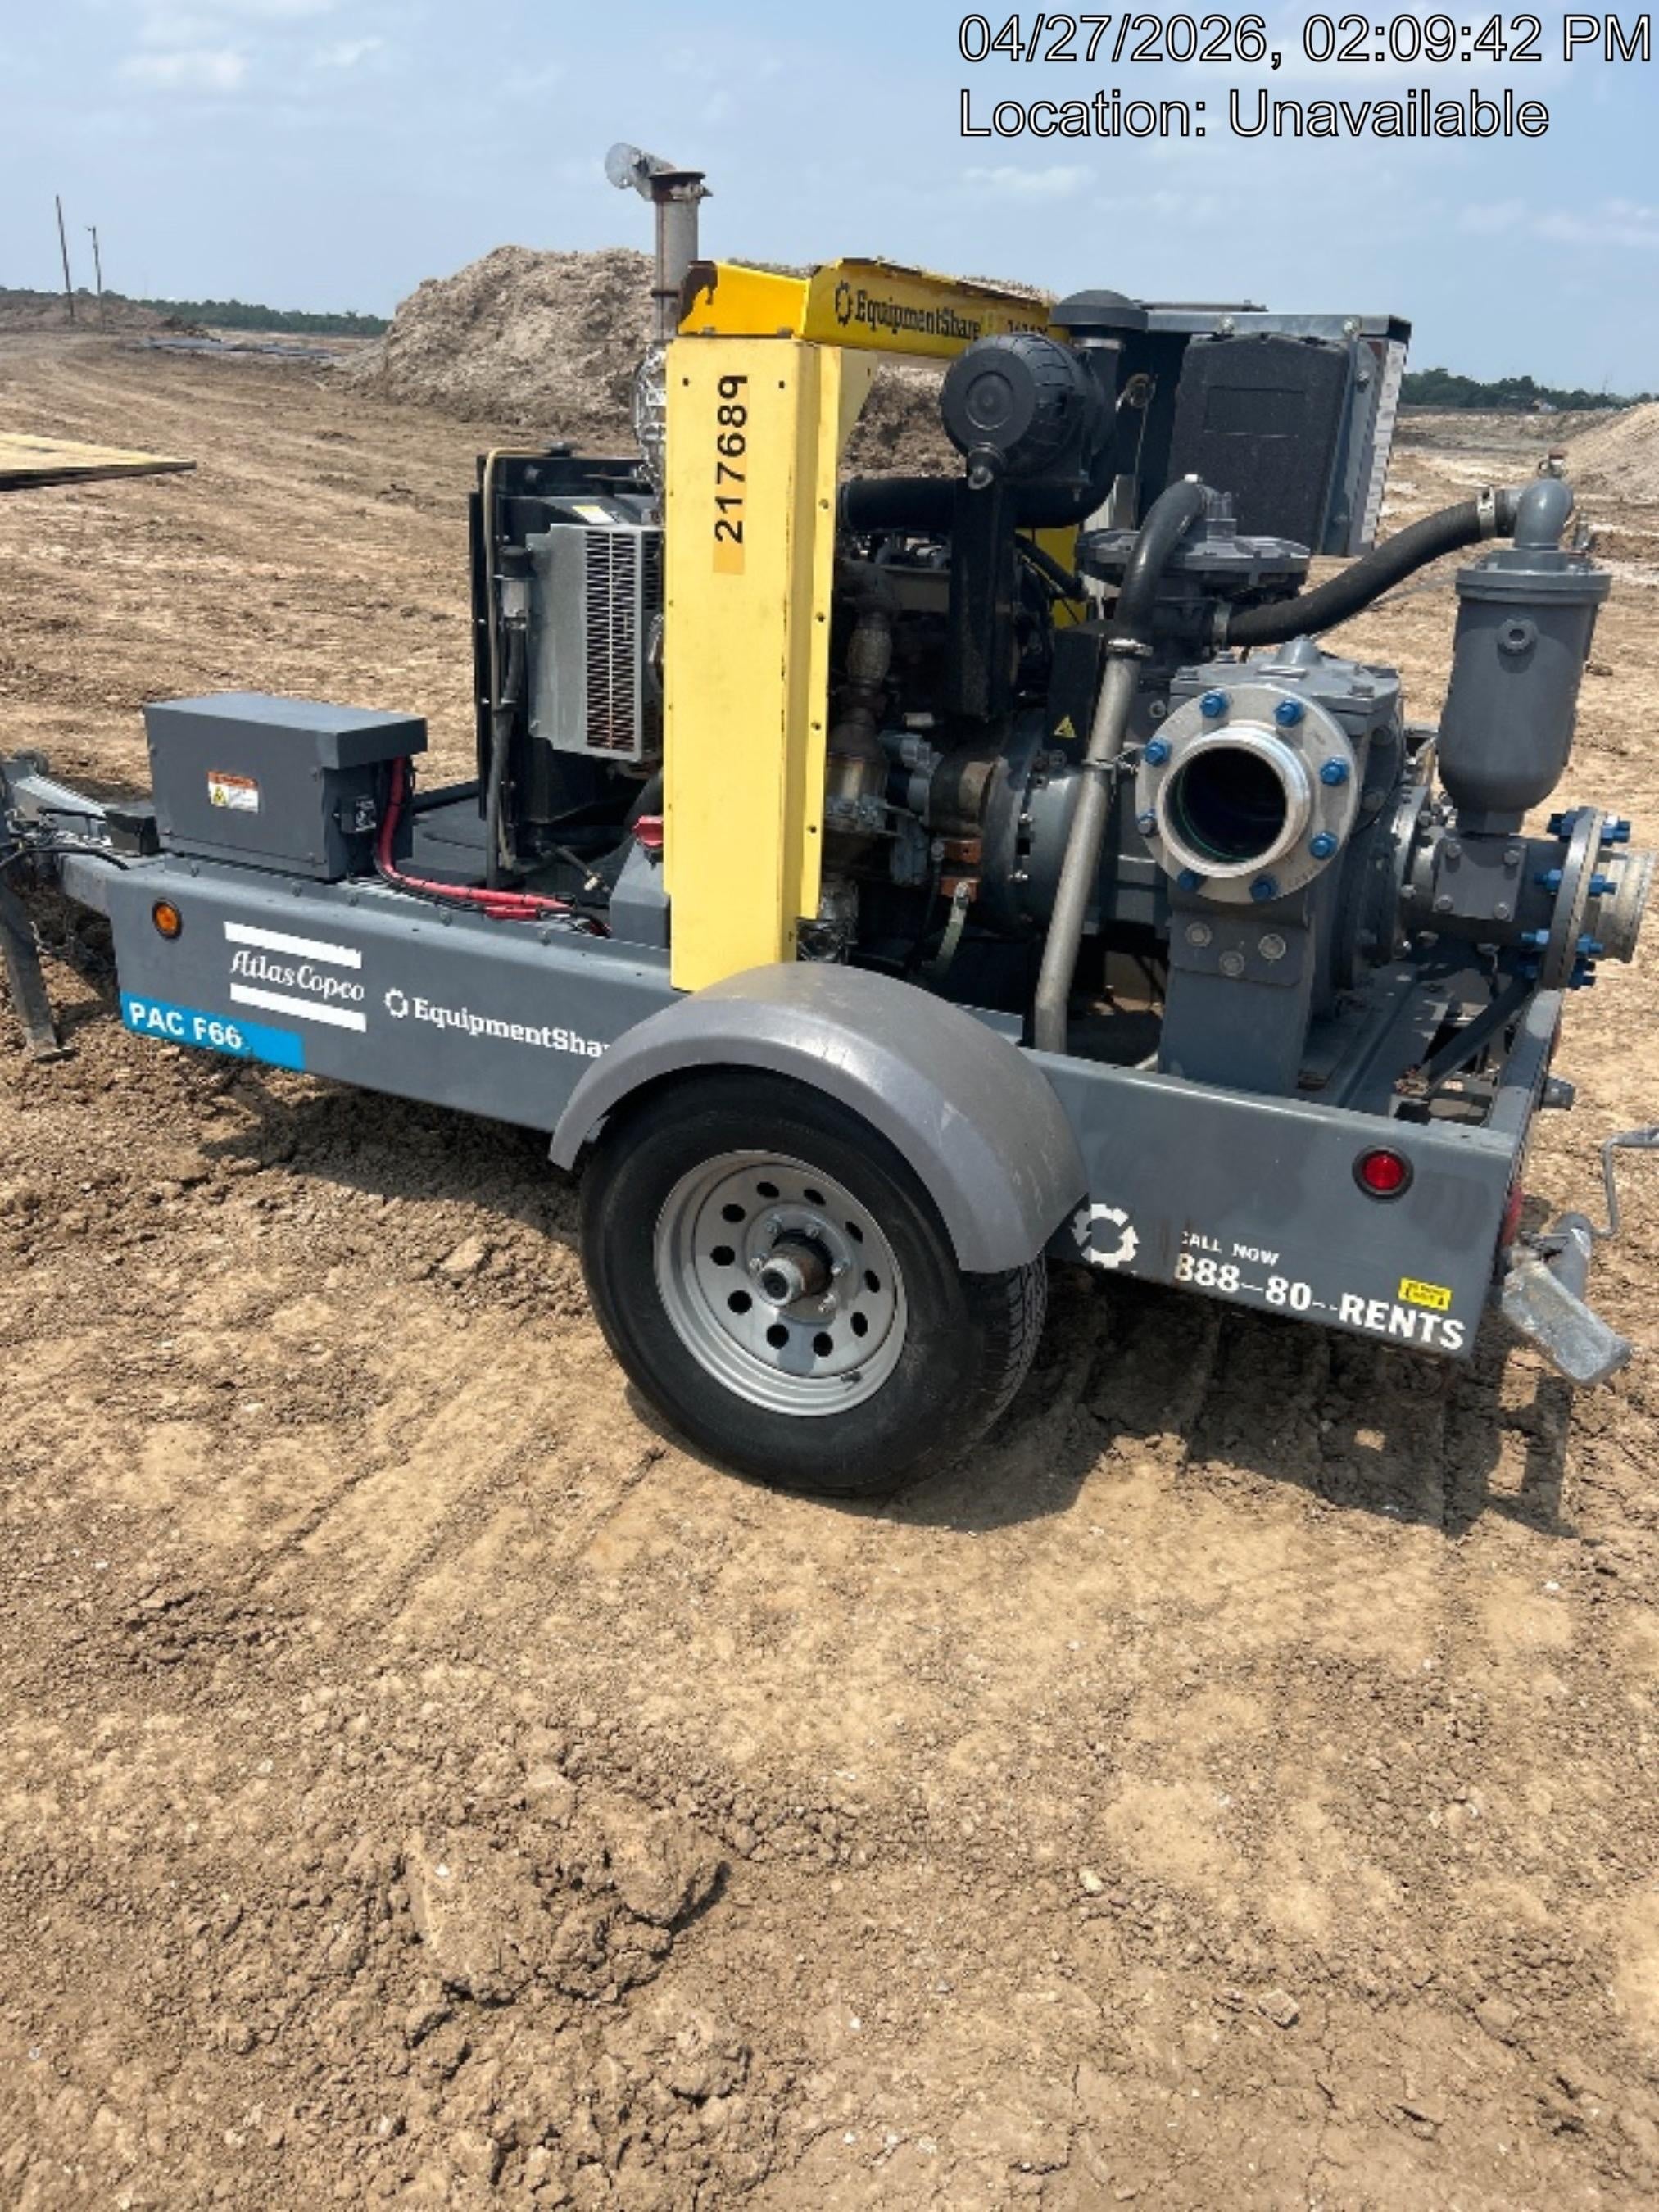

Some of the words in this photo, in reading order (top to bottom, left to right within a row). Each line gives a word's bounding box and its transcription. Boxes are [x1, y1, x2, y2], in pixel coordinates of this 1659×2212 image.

[855, 289, 981, 340] EquipmentShare
[714, 374, 748, 544] 217689
[229, 950, 296, 986] Atlas
[297, 964, 365, 1001] Copco
[129, 1002, 185, 1036] PAC
[193, 1017, 243, 1050] F66
[413, 997, 610, 1058] EquipmentSha
[1232, 1243, 1280, 1267] NOW
